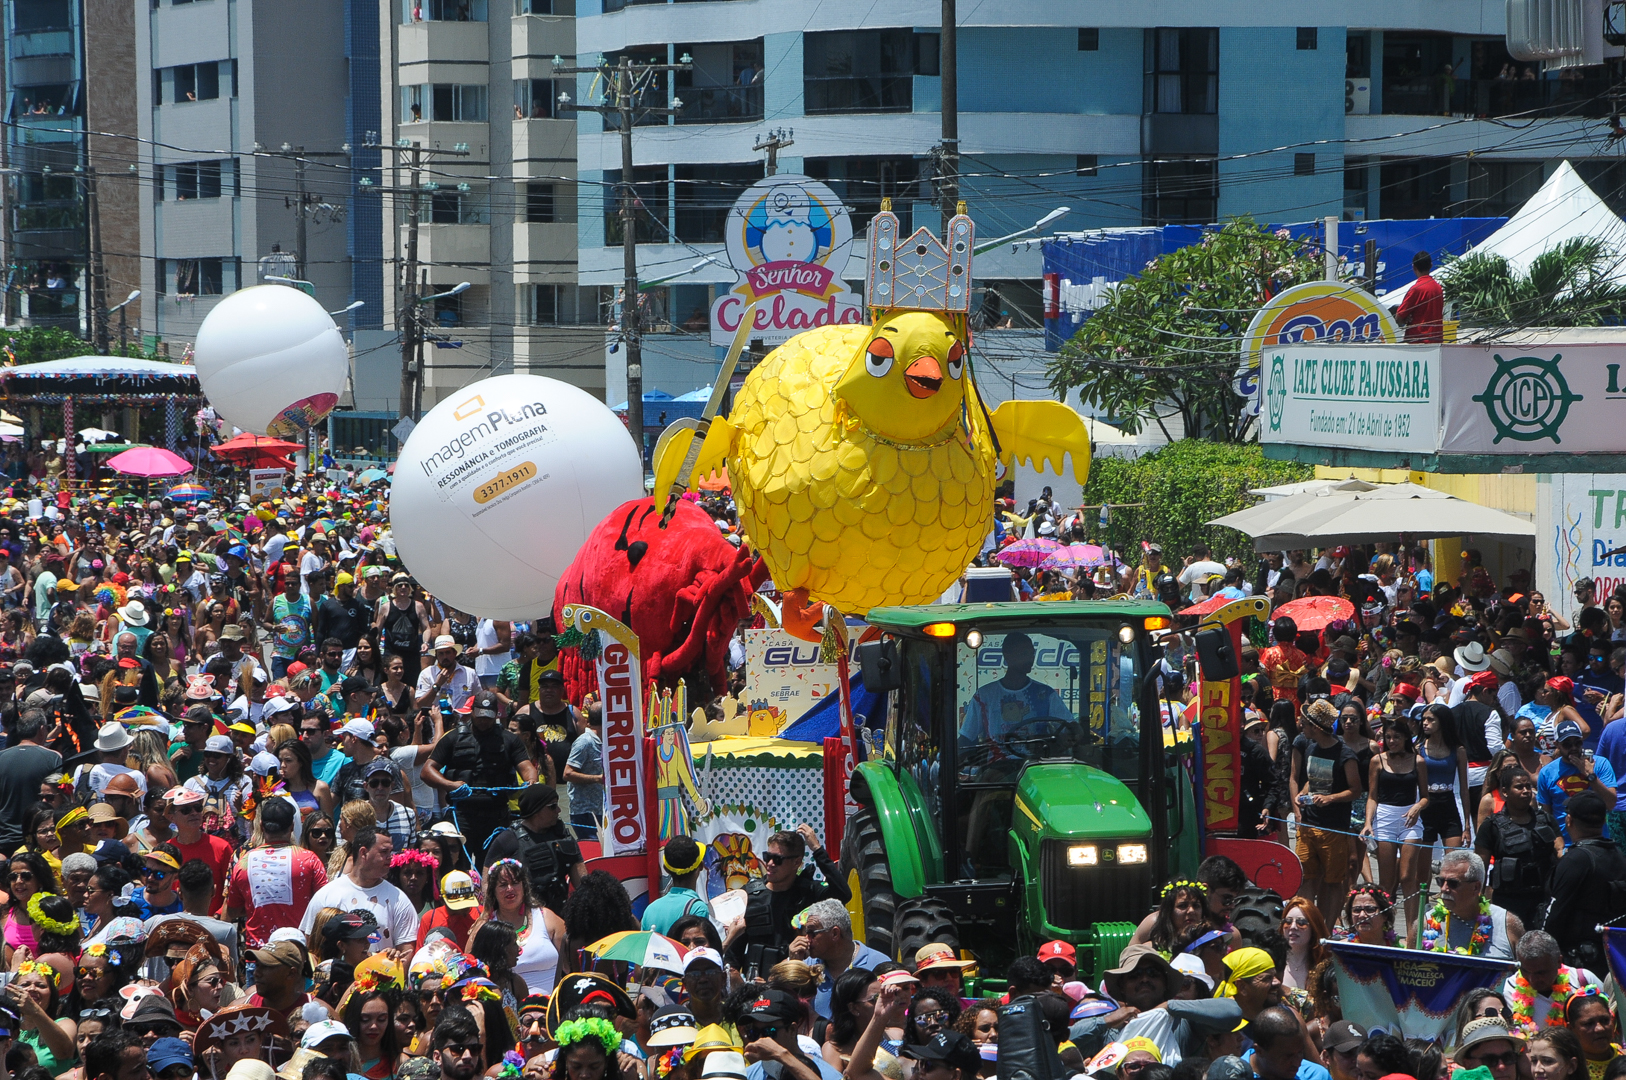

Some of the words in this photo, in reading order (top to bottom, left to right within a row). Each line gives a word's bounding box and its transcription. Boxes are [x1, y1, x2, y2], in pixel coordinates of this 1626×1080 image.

[756, 263, 823, 289] Senhor
[717, 295, 862, 332] Gelado
[1293, 359, 1318, 395] IATE
[1321, 359, 1356, 396] CLUBE
[1358, 359, 1430, 398] PAJUSSARA
[1513, 378, 1548, 419] ICP
[1309, 410, 1335, 433] Fundado
[1335, 415, 1347, 434] em:
[1348, 412, 1356, 435] 21
[1357, 413, 1365, 435] de
[1366, 413, 1382, 436] Abril
[1384, 414, 1392, 437] de
[1394, 414, 1411, 437] 1952
[437, 452, 489, 489] RESSONÂNCIA
[494, 424, 548, 452] TOMOGRAFIA
[462, 467, 481, 482] qualidade
[488, 453, 507, 466] conforto
[481, 467, 530, 498] 3377.1911
[1063, 690, 1080, 699] SE
[603, 643, 642, 845] GUERREIRO
[1203, 676, 1235, 826] EGANÇA
[1393, 961, 1418, 972] LIGA
[1397, 970, 1445, 979] RNAVALESCA
